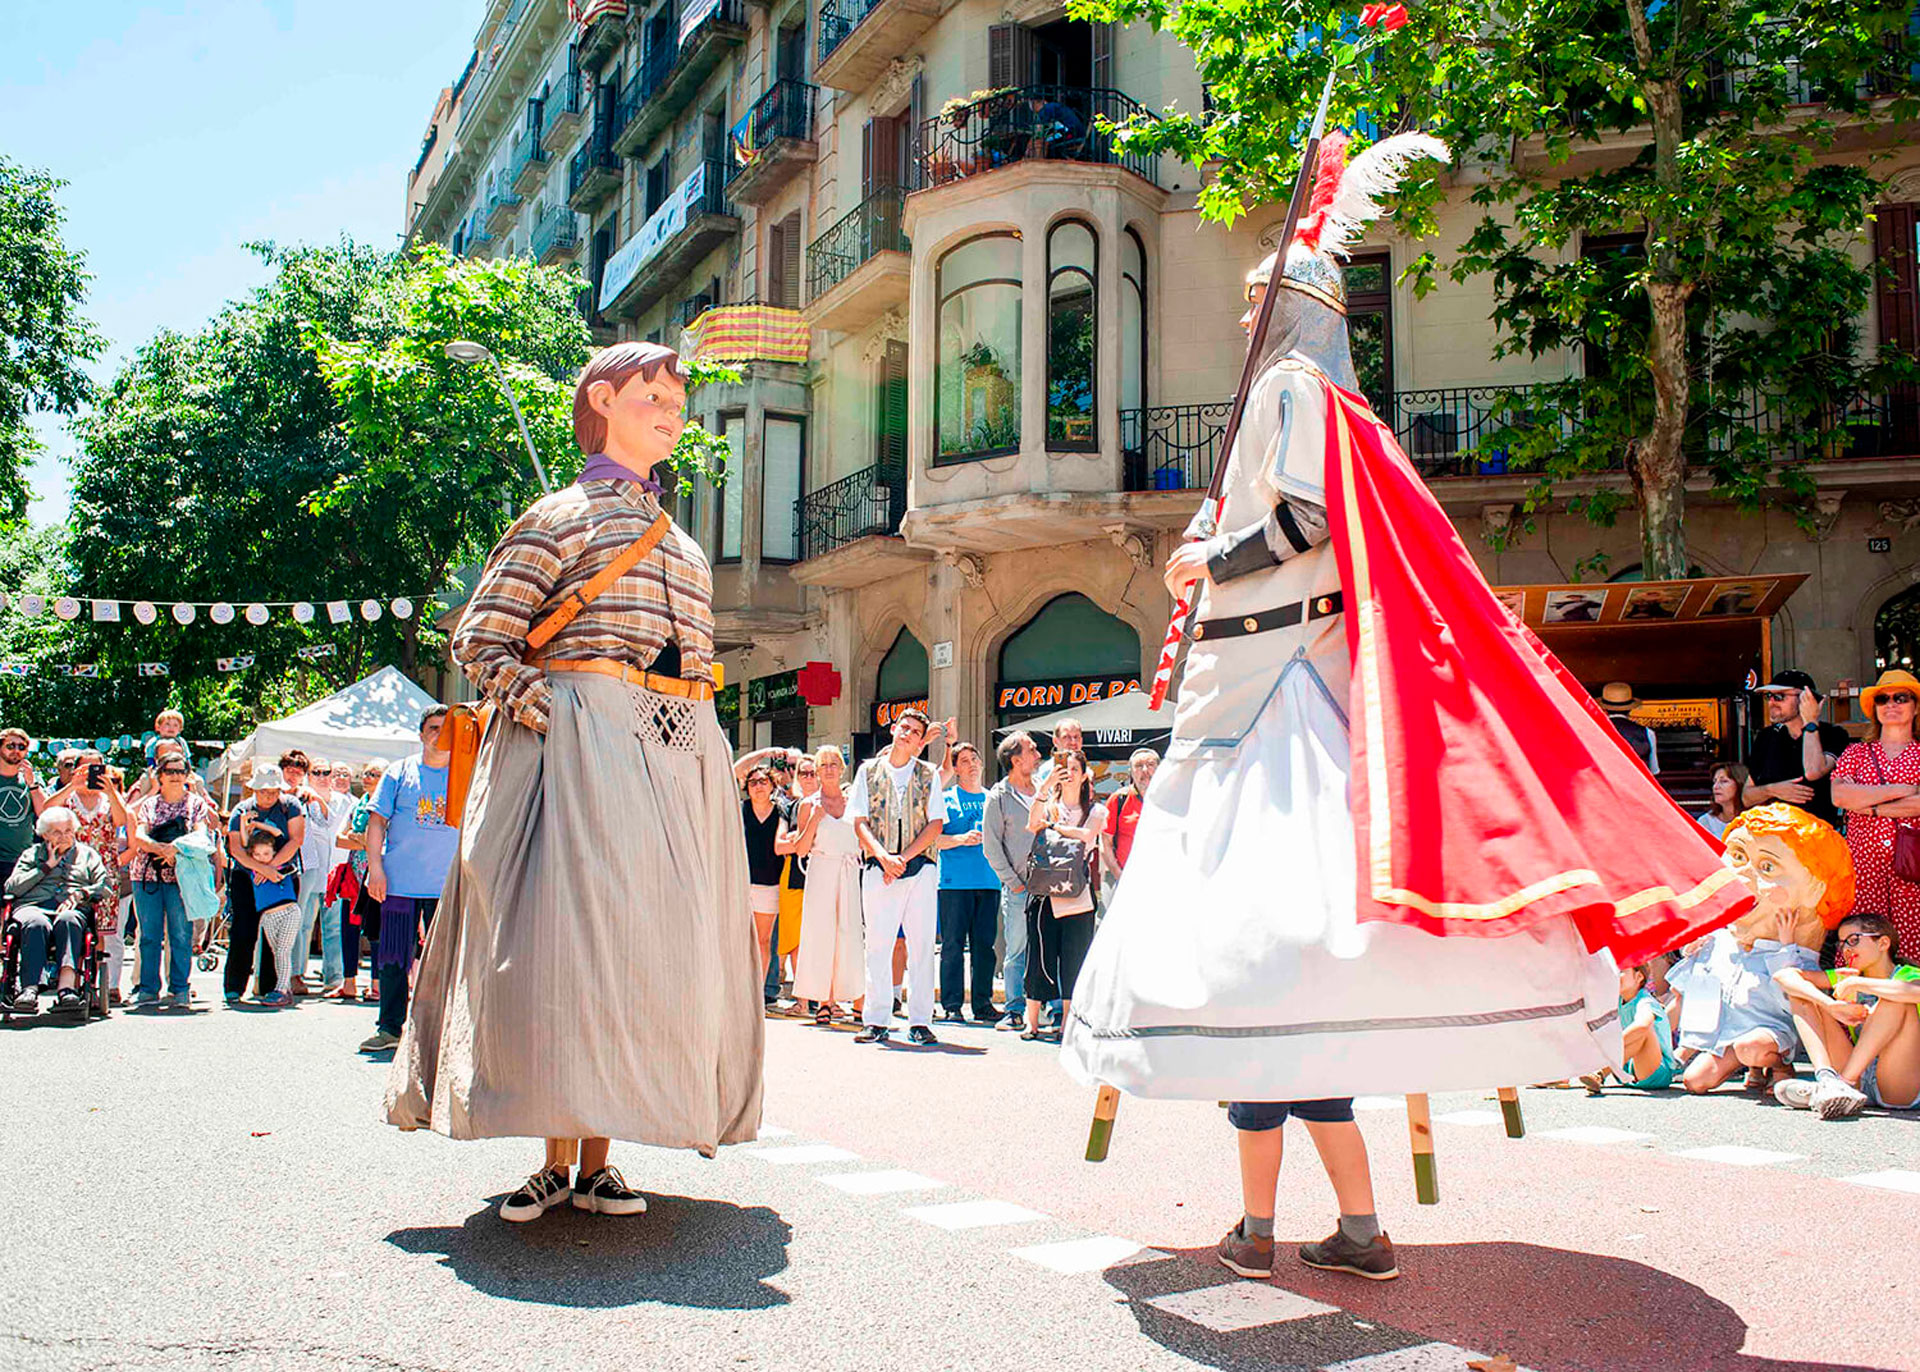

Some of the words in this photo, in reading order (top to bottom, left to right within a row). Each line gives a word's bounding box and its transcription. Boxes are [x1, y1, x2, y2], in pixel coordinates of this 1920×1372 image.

[1870, 540, 1888, 551] 125
[999, 684, 1063, 708] FORN
[1069, 682, 1103, 704] DE
[1096, 728, 1133, 743] VIVARI
